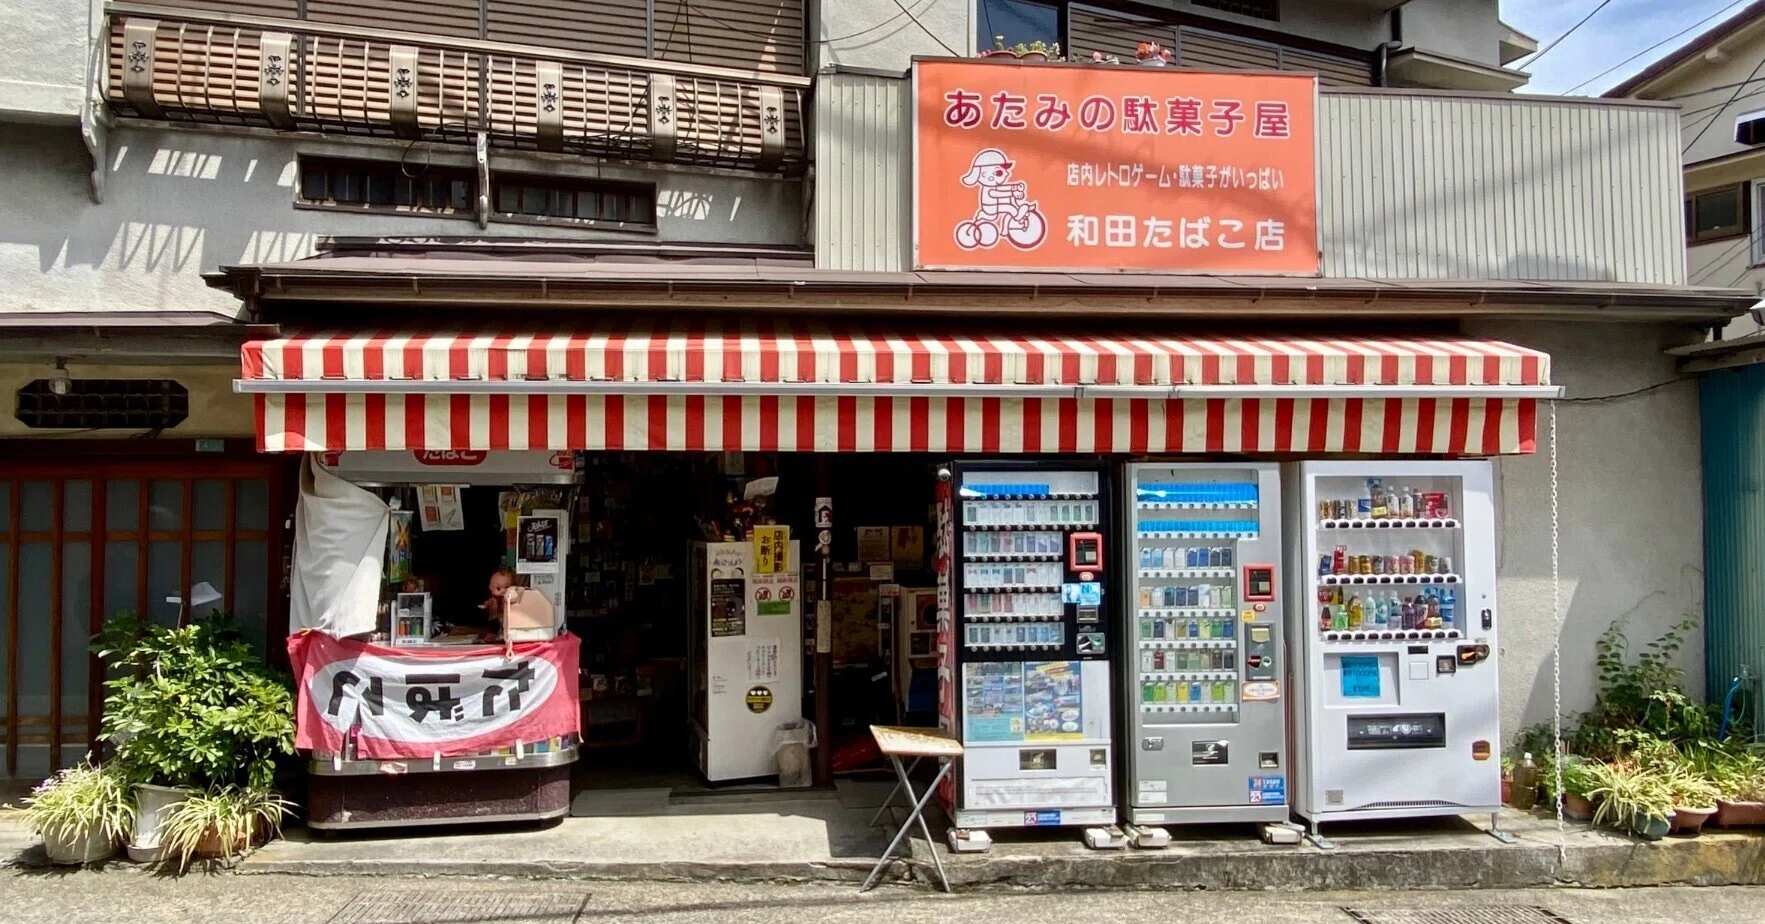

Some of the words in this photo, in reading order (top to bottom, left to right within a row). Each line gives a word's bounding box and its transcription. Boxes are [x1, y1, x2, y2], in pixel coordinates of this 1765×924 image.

[944, 88, 1290, 138] あたみの駄菓子屋
[1067, 163, 1284, 190] 店内レトロゲーム・駄菓子がいっぱい
[1067, 215, 1285, 251] 和田たばこ店
